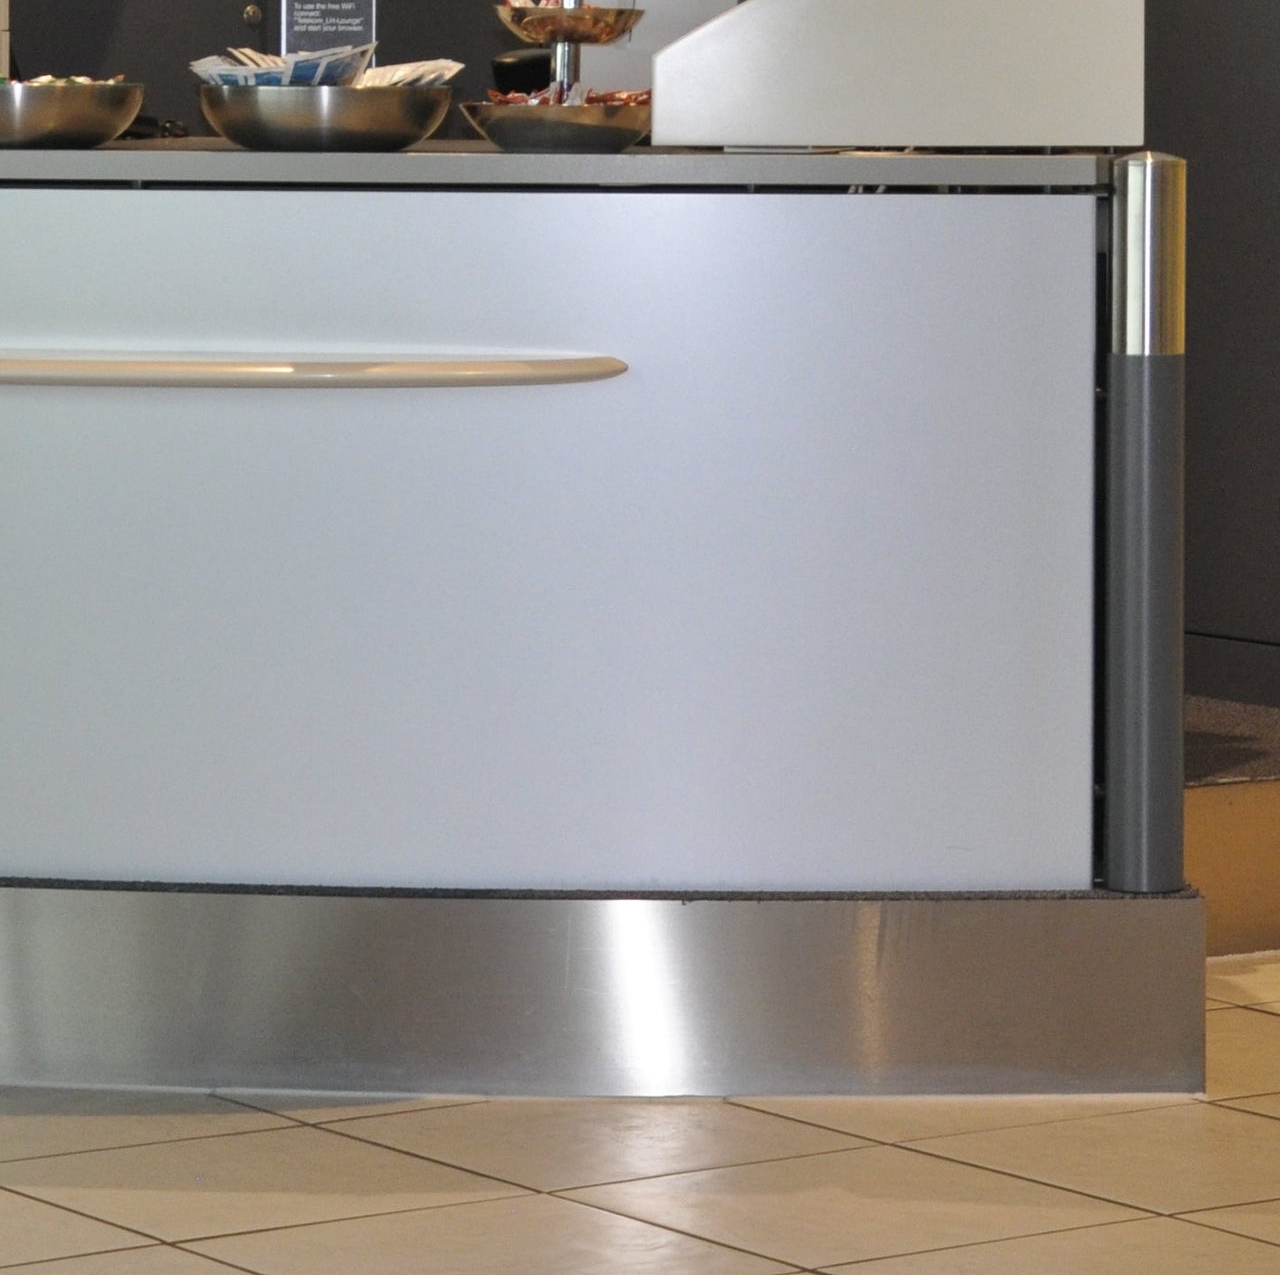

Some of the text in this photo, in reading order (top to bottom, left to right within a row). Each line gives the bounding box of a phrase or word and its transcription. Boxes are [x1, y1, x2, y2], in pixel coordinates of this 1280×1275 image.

[294, 2, 302, 10] To
[302, 2, 315, 10] use
[315, 2, 326, 10] the
[327, 2, 340, 10] free
[322, 25, 337, 33] your
